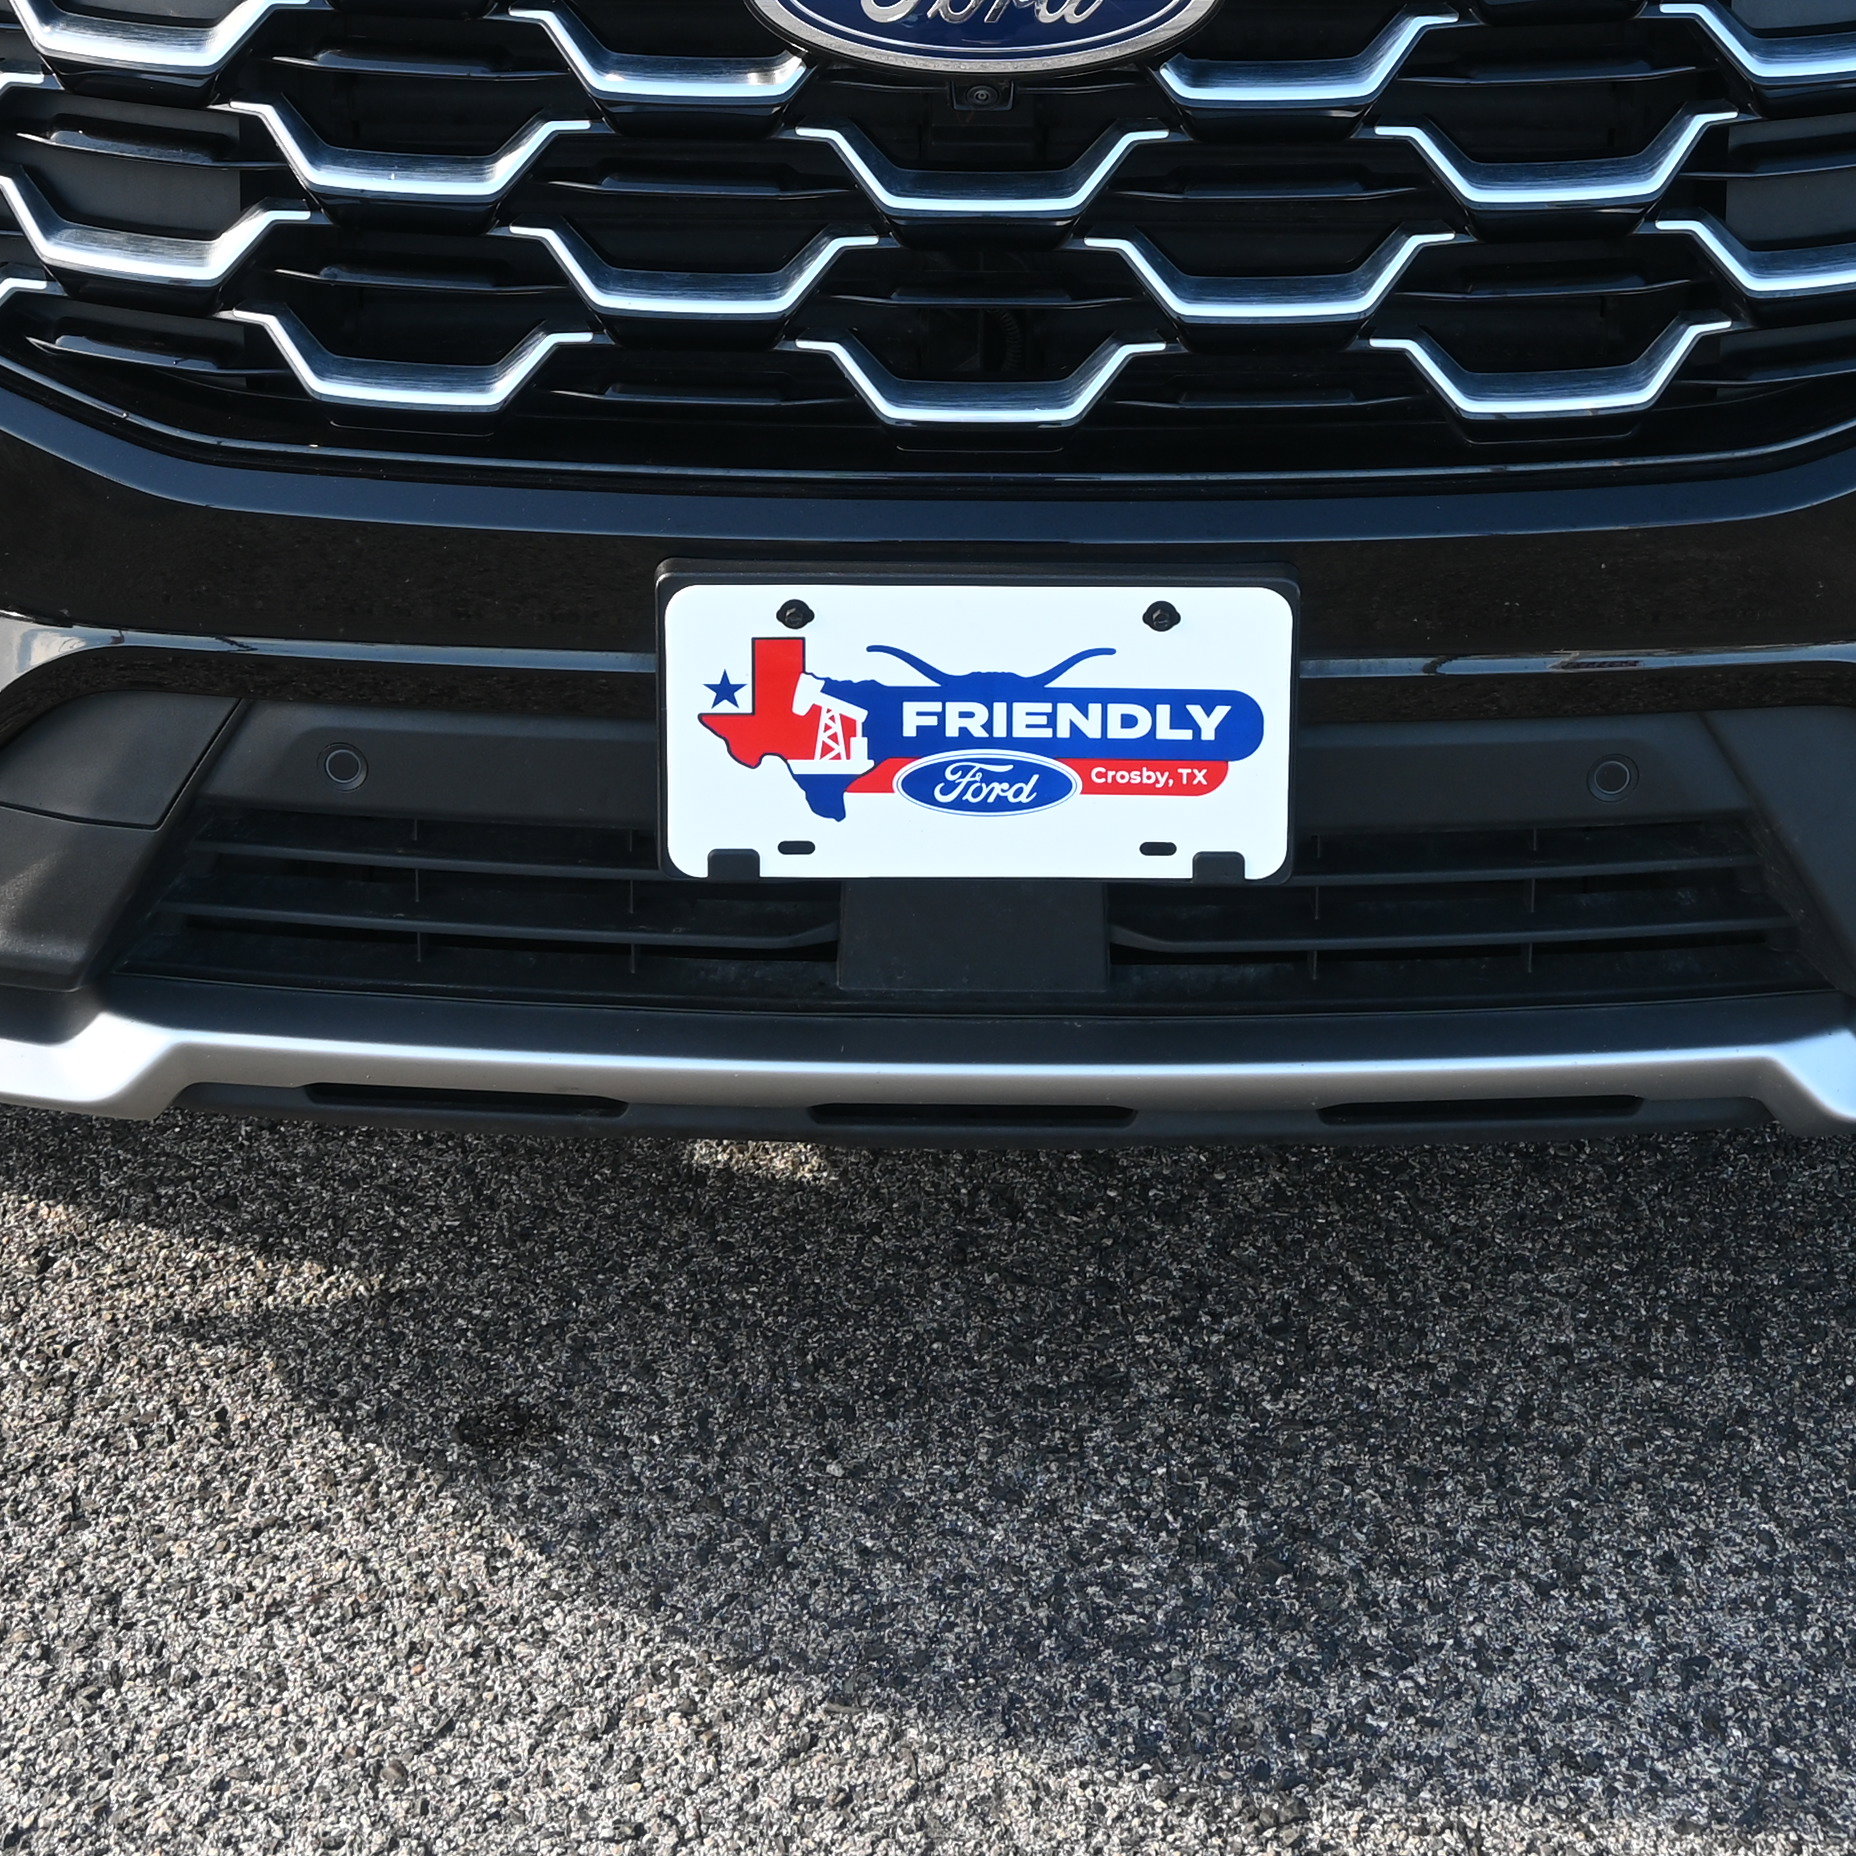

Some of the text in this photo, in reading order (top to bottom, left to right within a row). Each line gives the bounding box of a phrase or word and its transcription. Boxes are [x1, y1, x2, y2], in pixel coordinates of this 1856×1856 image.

[901, 700, 1232, 742] FRIENDLY
[933, 761, 1038, 804] Ford
[1090, 764, 1208, 789] Crosby, TX
